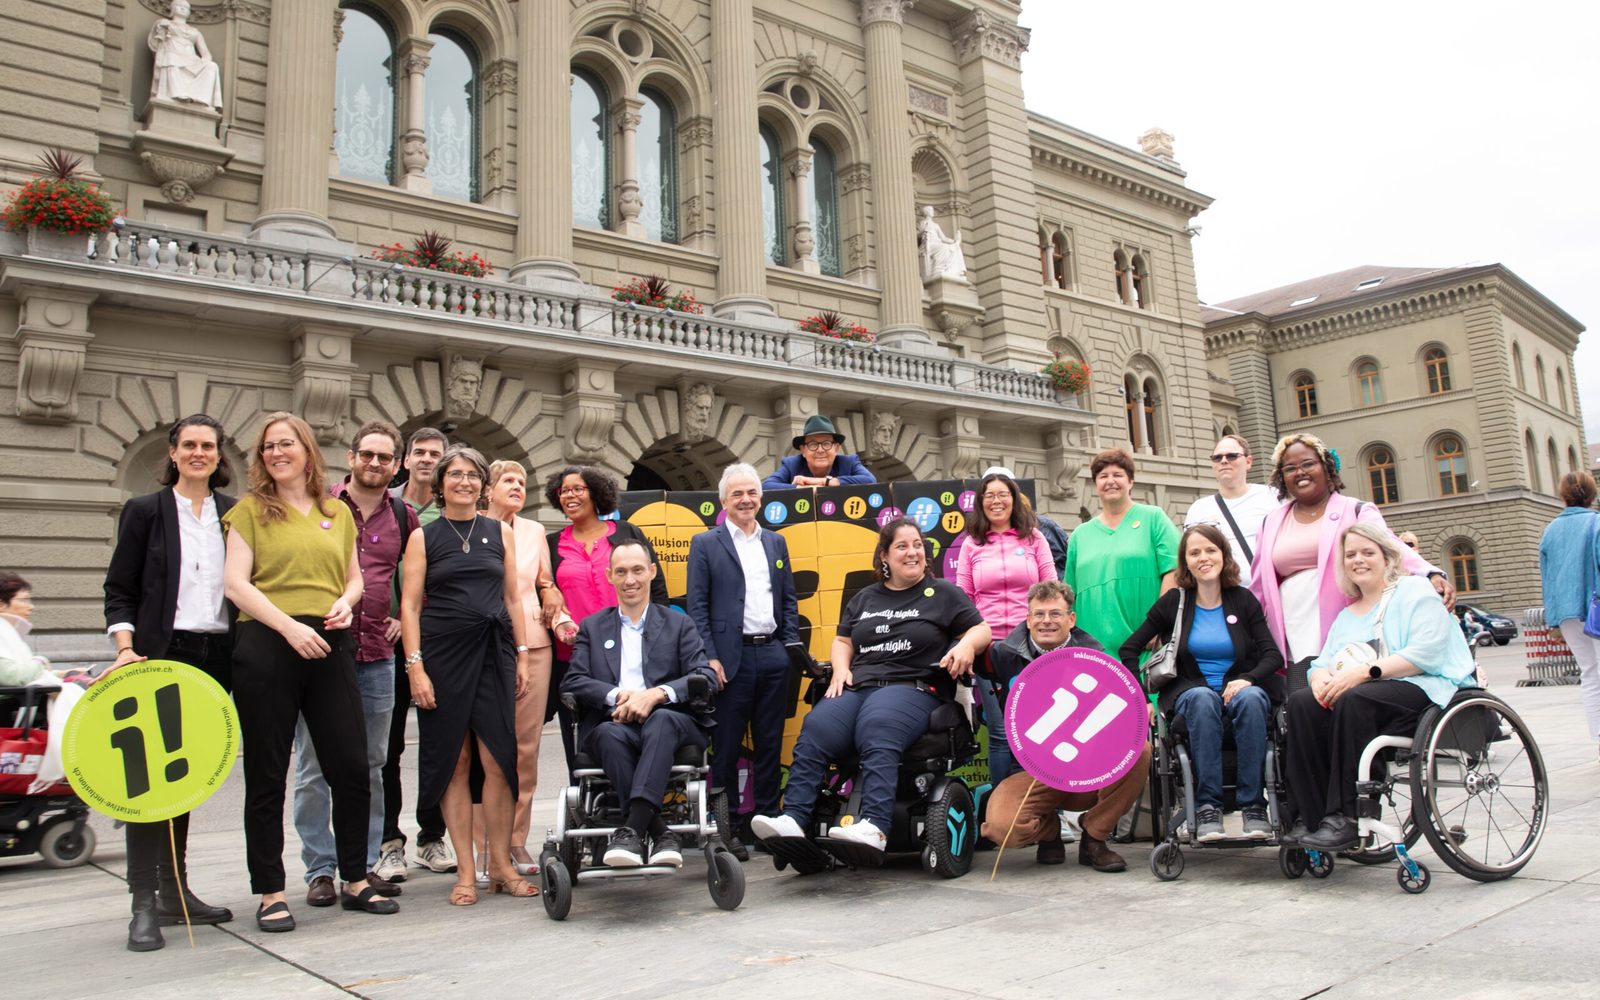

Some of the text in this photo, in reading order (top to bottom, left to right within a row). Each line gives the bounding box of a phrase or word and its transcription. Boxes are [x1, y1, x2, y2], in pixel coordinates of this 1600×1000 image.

[875, 624, 891, 634] are
[88, 666, 173, 703] inklusions-initiative.ch
[1073, 652, 1136, 694] inklusions-initiative.ch
[1009, 681, 1026, 752] initiative-inclusion.ch
[111, 682, 190, 800] i!
[72, 767, 141, 816] initiative-inclusion.ch
